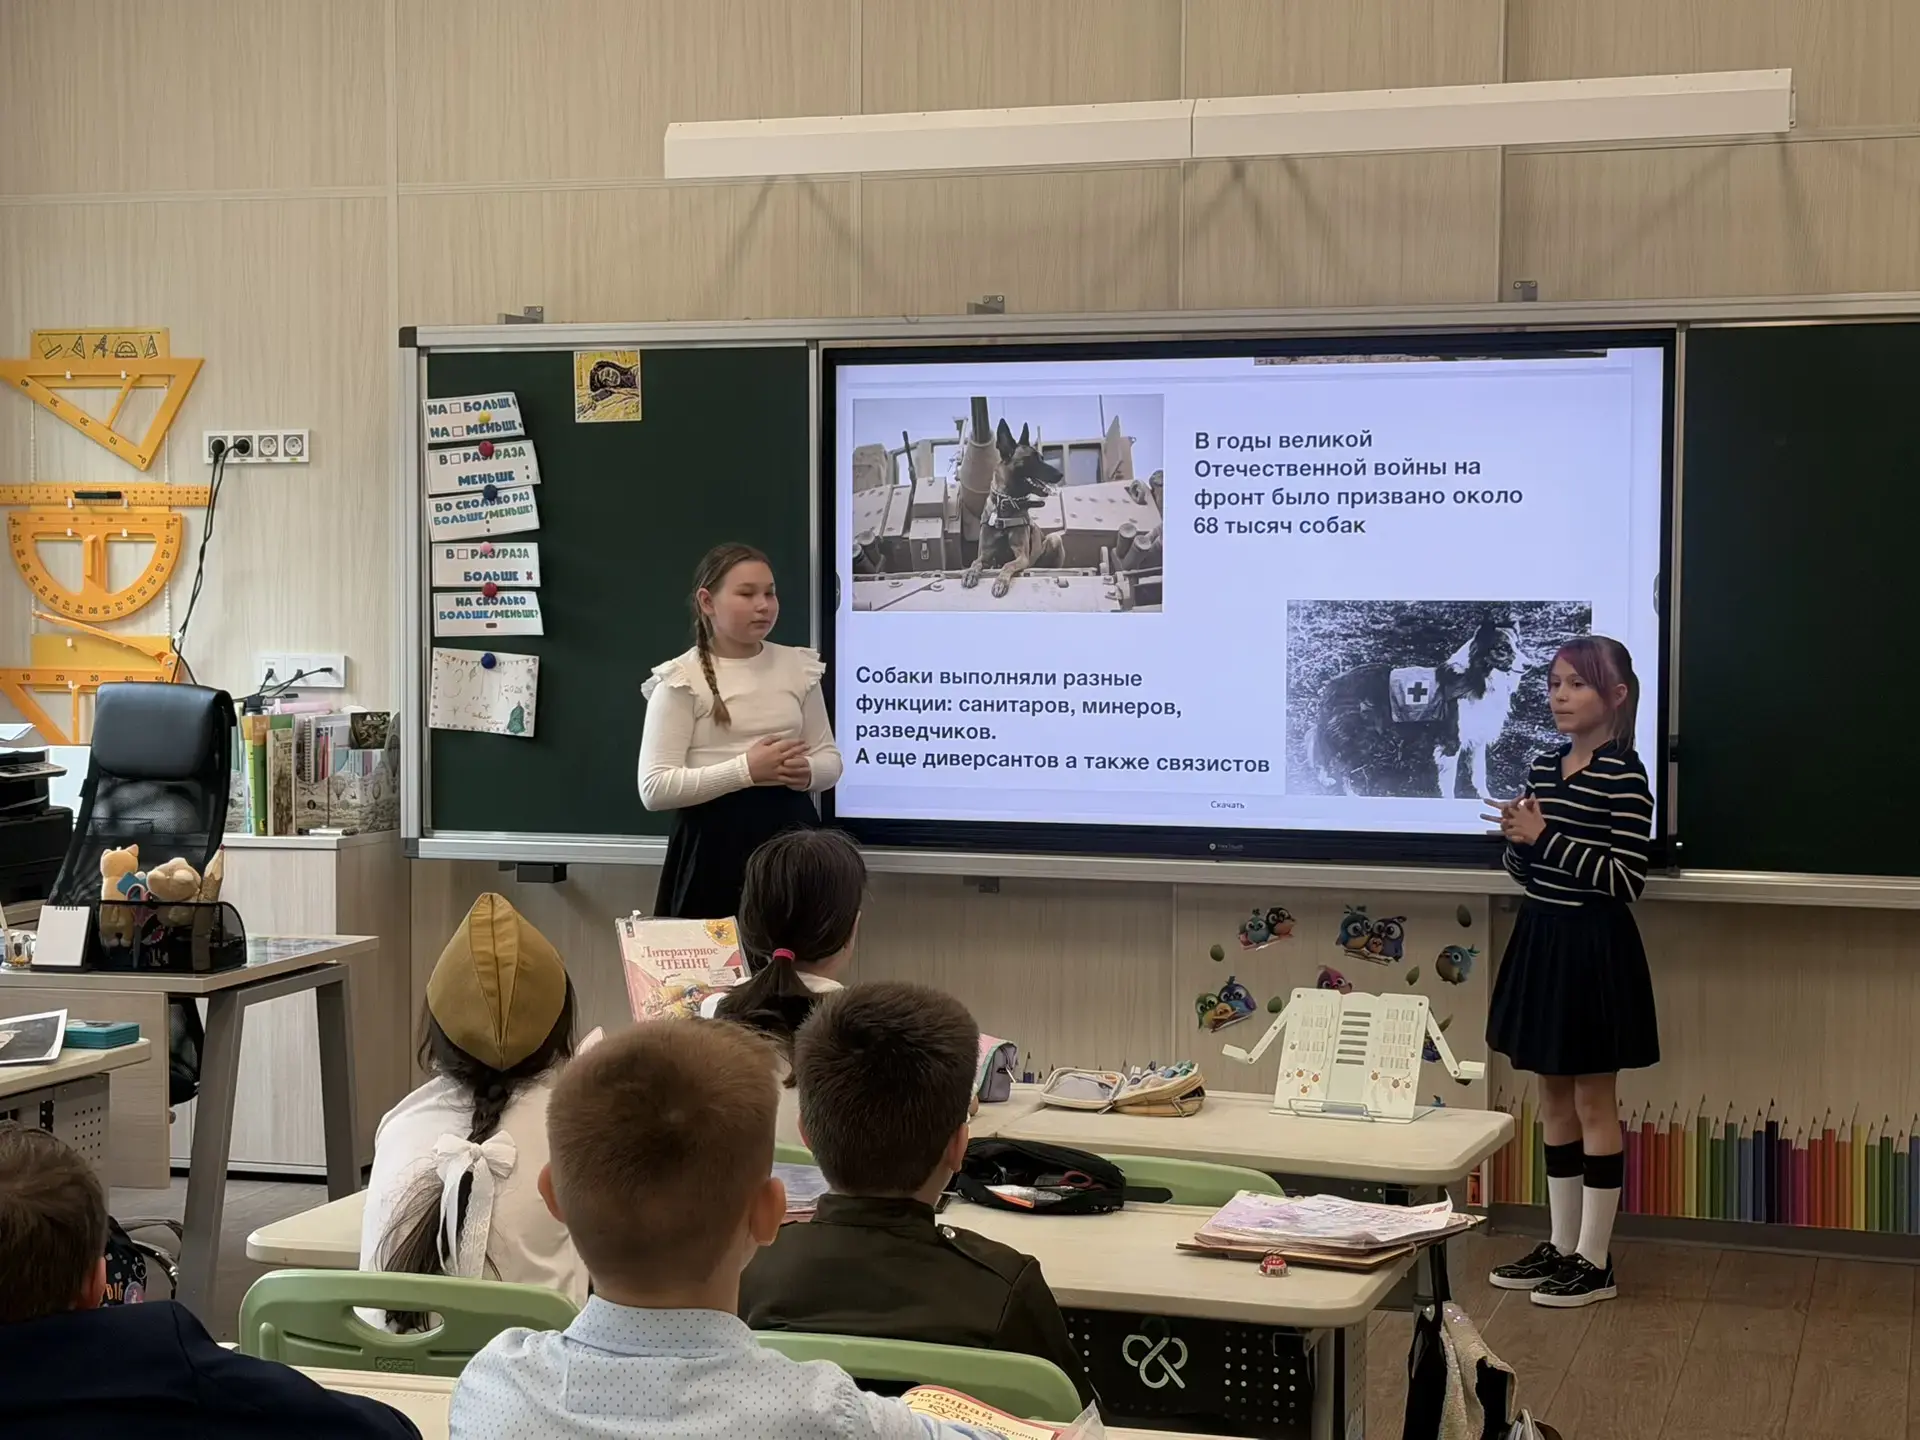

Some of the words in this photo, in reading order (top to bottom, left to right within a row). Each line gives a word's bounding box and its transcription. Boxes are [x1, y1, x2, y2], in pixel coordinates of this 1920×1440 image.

[427, 404, 448, 415] НА
[463, 397, 511, 412] БОЛЬШЕ
[430, 427, 450, 438] НА
[466, 420, 517, 435] МЕНЬШЕ
[1195, 431, 1210, 450] В
[1217, 435, 1271, 453] годы
[1279, 429, 1372, 449] великой
[440, 455, 448, 465] В
[1194, 458, 1367, 478] Отечественной
[1374, 457, 1447, 476] войны
[1454, 461, 1481, 475] на
[457, 471, 516, 486] МЕНЬШЕ
[435, 502, 453, 512] ВО
[512, 491, 530, 502] РАЗ
[1194, 488, 1266, 510] фронт
[1271, 487, 1330, 506] было
[1337, 490, 1446, 509] призвано
[1452, 489, 1523, 504] около
[433, 504, 534, 525] БОЛЬШЕ/МЕНЬШЕ?
[1193, 516, 1219, 534] 68
[1224, 520, 1292, 534] тысяч
[1299, 515, 1366, 534] собак
[446, 549, 455, 559] В
[463, 571, 519, 581] БОЛЬШЕ
[455, 597, 473, 607] НА
[475, 596, 526, 606] СКОЛЬКО
[439, 609, 539, 620] БОЛЬШЕ/МЕНЬШЕ?
[90, 674, 99, 682] 30
[856, 665, 933, 684] Собаки
[939, 671, 1057, 686] выполняли
[1063, 672, 1143, 690] разные
[855, 693, 952, 715] функции:
[958, 698, 1076, 717] санитаров,
[1082, 700, 1182, 719] минеров,
[855, 724, 996, 742] разведчиков.
[855, 747, 870, 765] А
[875, 751, 917, 769] еще
[922, 752, 1059, 771] диверсантов
[1065, 755, 1077, 769] а
[1083, 756, 1150, 771] также
[1156, 757, 1270, 773] связистов
[1210, 800, 1245, 809] Скачать
[656, 958, 710, 969] ЧТЕНИЕ
